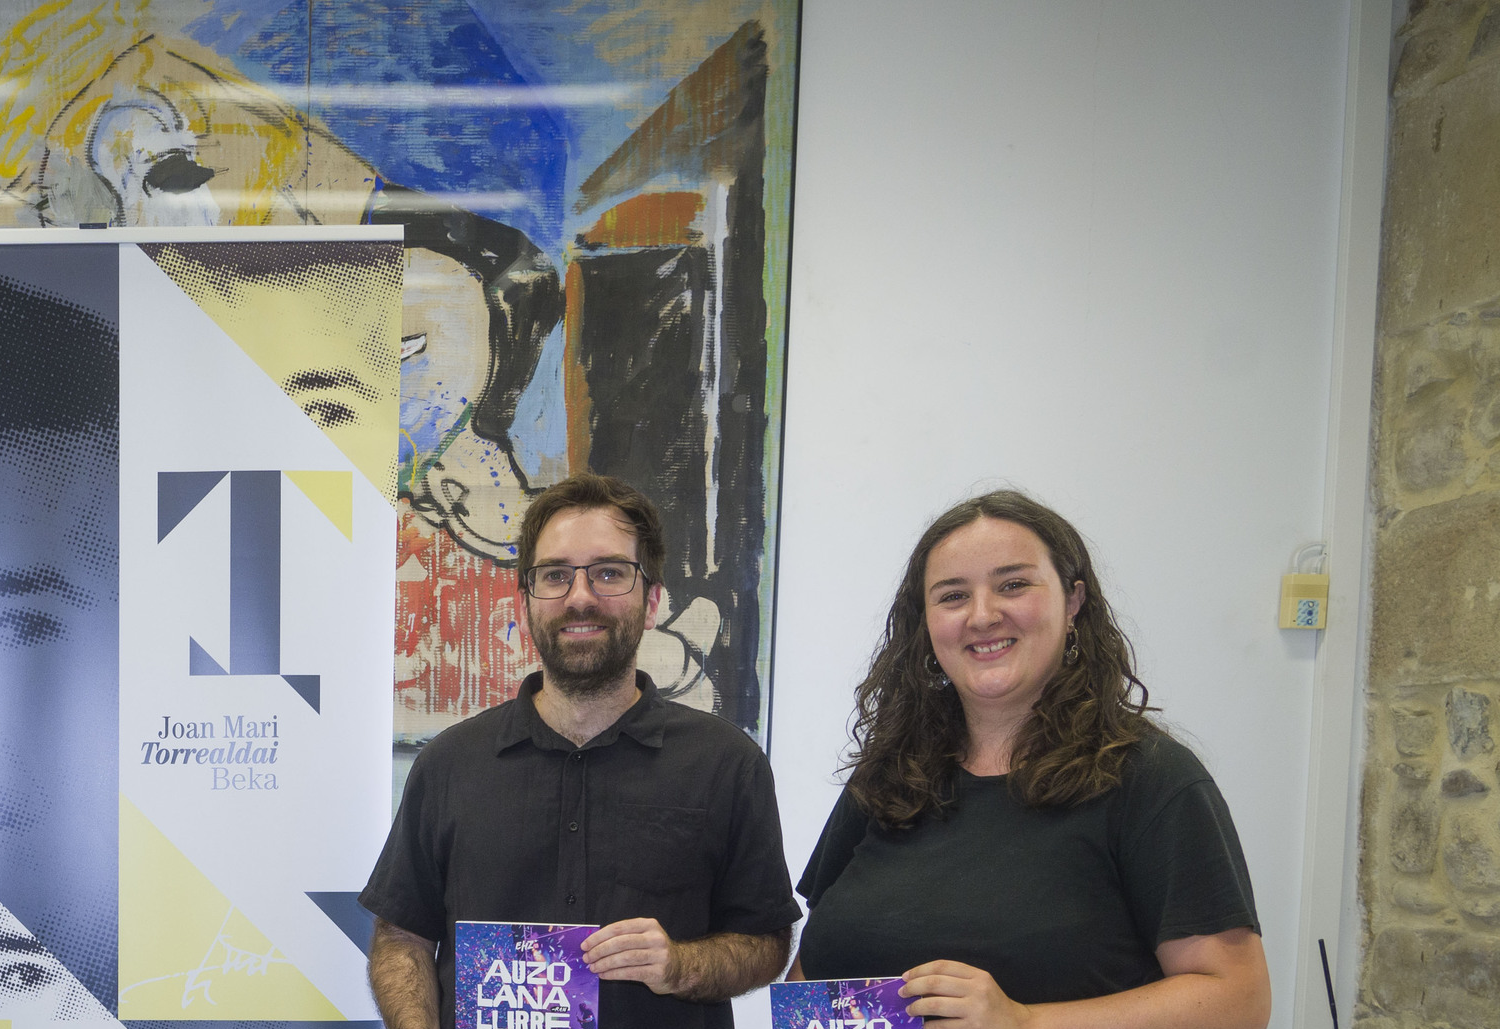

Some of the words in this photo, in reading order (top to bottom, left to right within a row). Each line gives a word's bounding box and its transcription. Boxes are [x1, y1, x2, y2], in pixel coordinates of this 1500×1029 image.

[158, 716, 215, 739] Joan
[222, 715, 279, 738] Mari
[140, 741, 279, 765] Torrealdai
[210, 767, 279, 790] Beka
[483, 959, 572, 986] AUZO
[477, 983, 571, 1010] LANA
